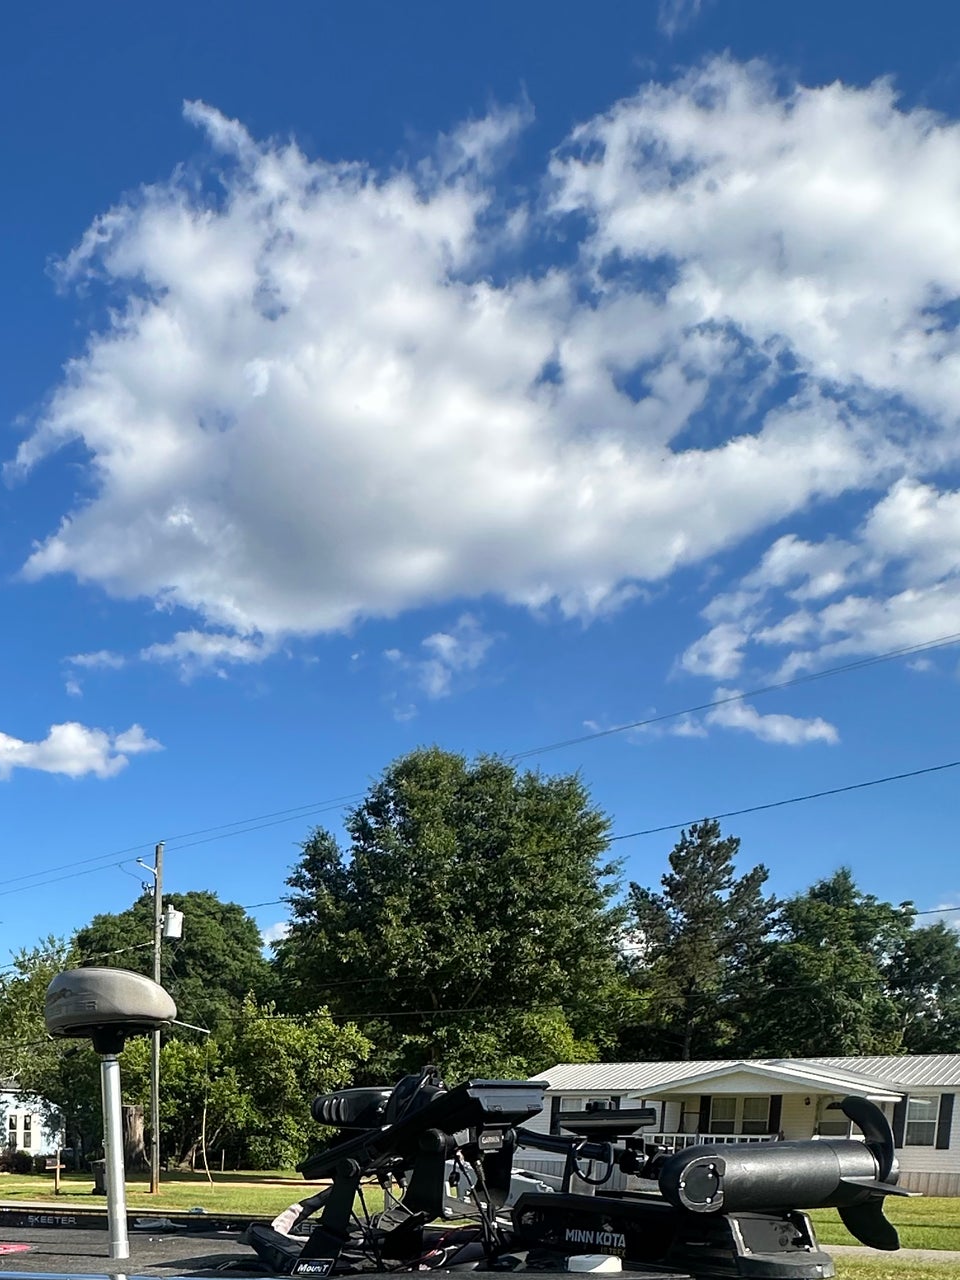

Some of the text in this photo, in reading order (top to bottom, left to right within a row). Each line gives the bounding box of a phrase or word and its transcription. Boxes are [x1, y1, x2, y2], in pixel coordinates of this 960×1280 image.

[27, 1215, 78, 1225] SKEETER
[565, 1228, 626, 1248] MINN KOTA
